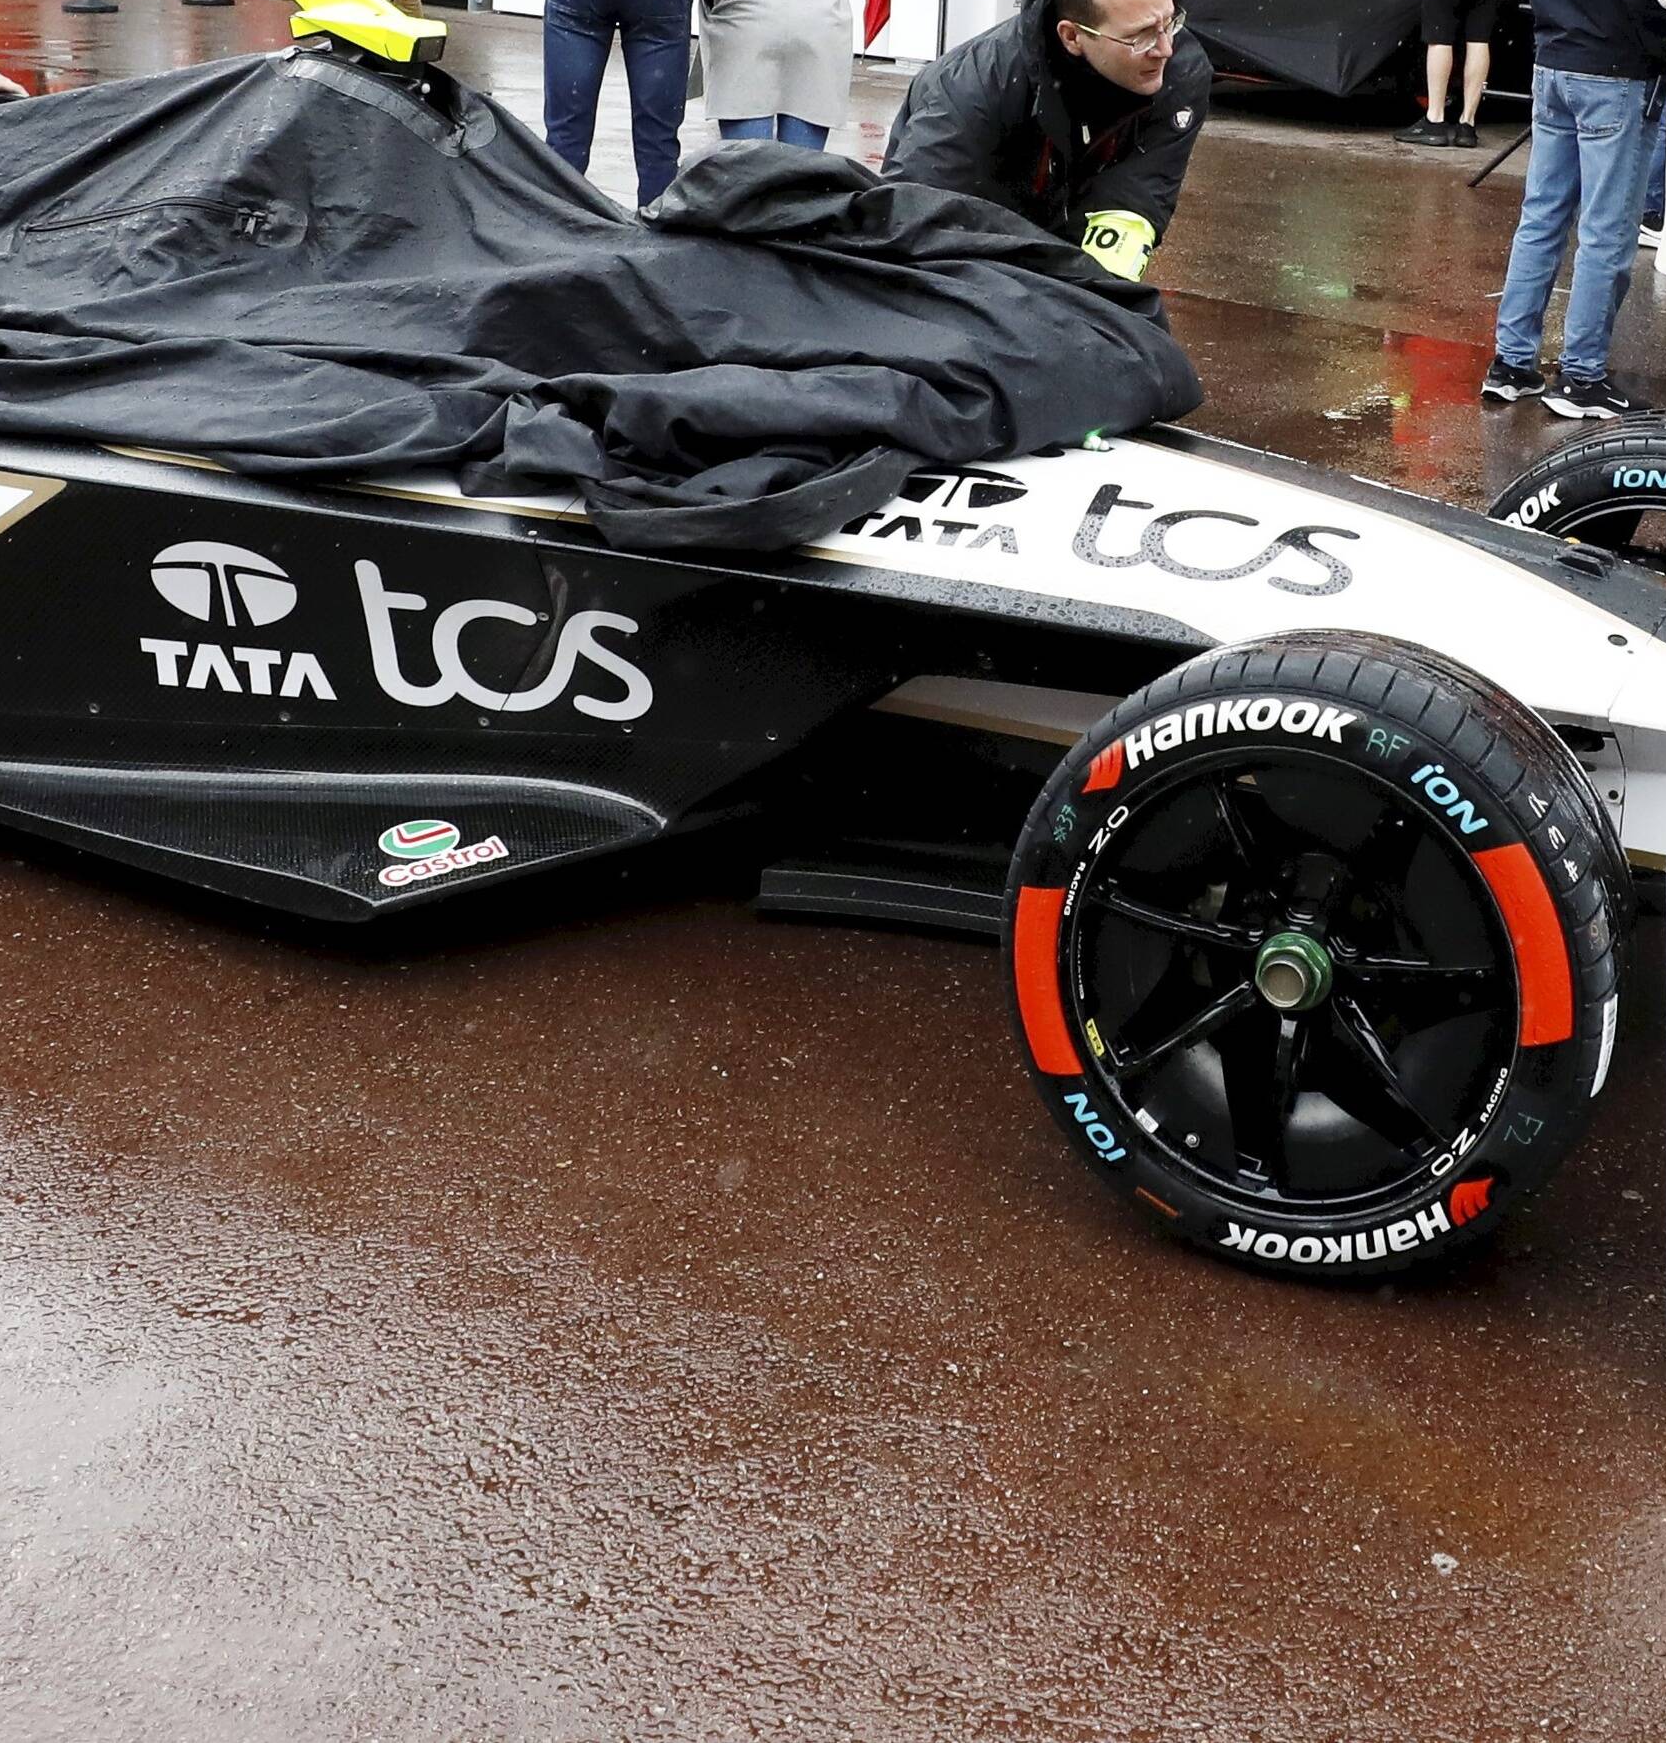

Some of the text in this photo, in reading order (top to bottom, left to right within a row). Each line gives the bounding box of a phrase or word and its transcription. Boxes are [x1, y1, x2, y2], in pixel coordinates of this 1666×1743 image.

[1083, 225, 1120, 251] 10
[840, 483, 1361, 597] TATA tcs
[139, 558, 655, 721] TATA tcs
[381, 838, 507, 885] Castrol
[1063, 861, 1086, 917] RACING
[1479, 1066, 1509, 1124] RACING
